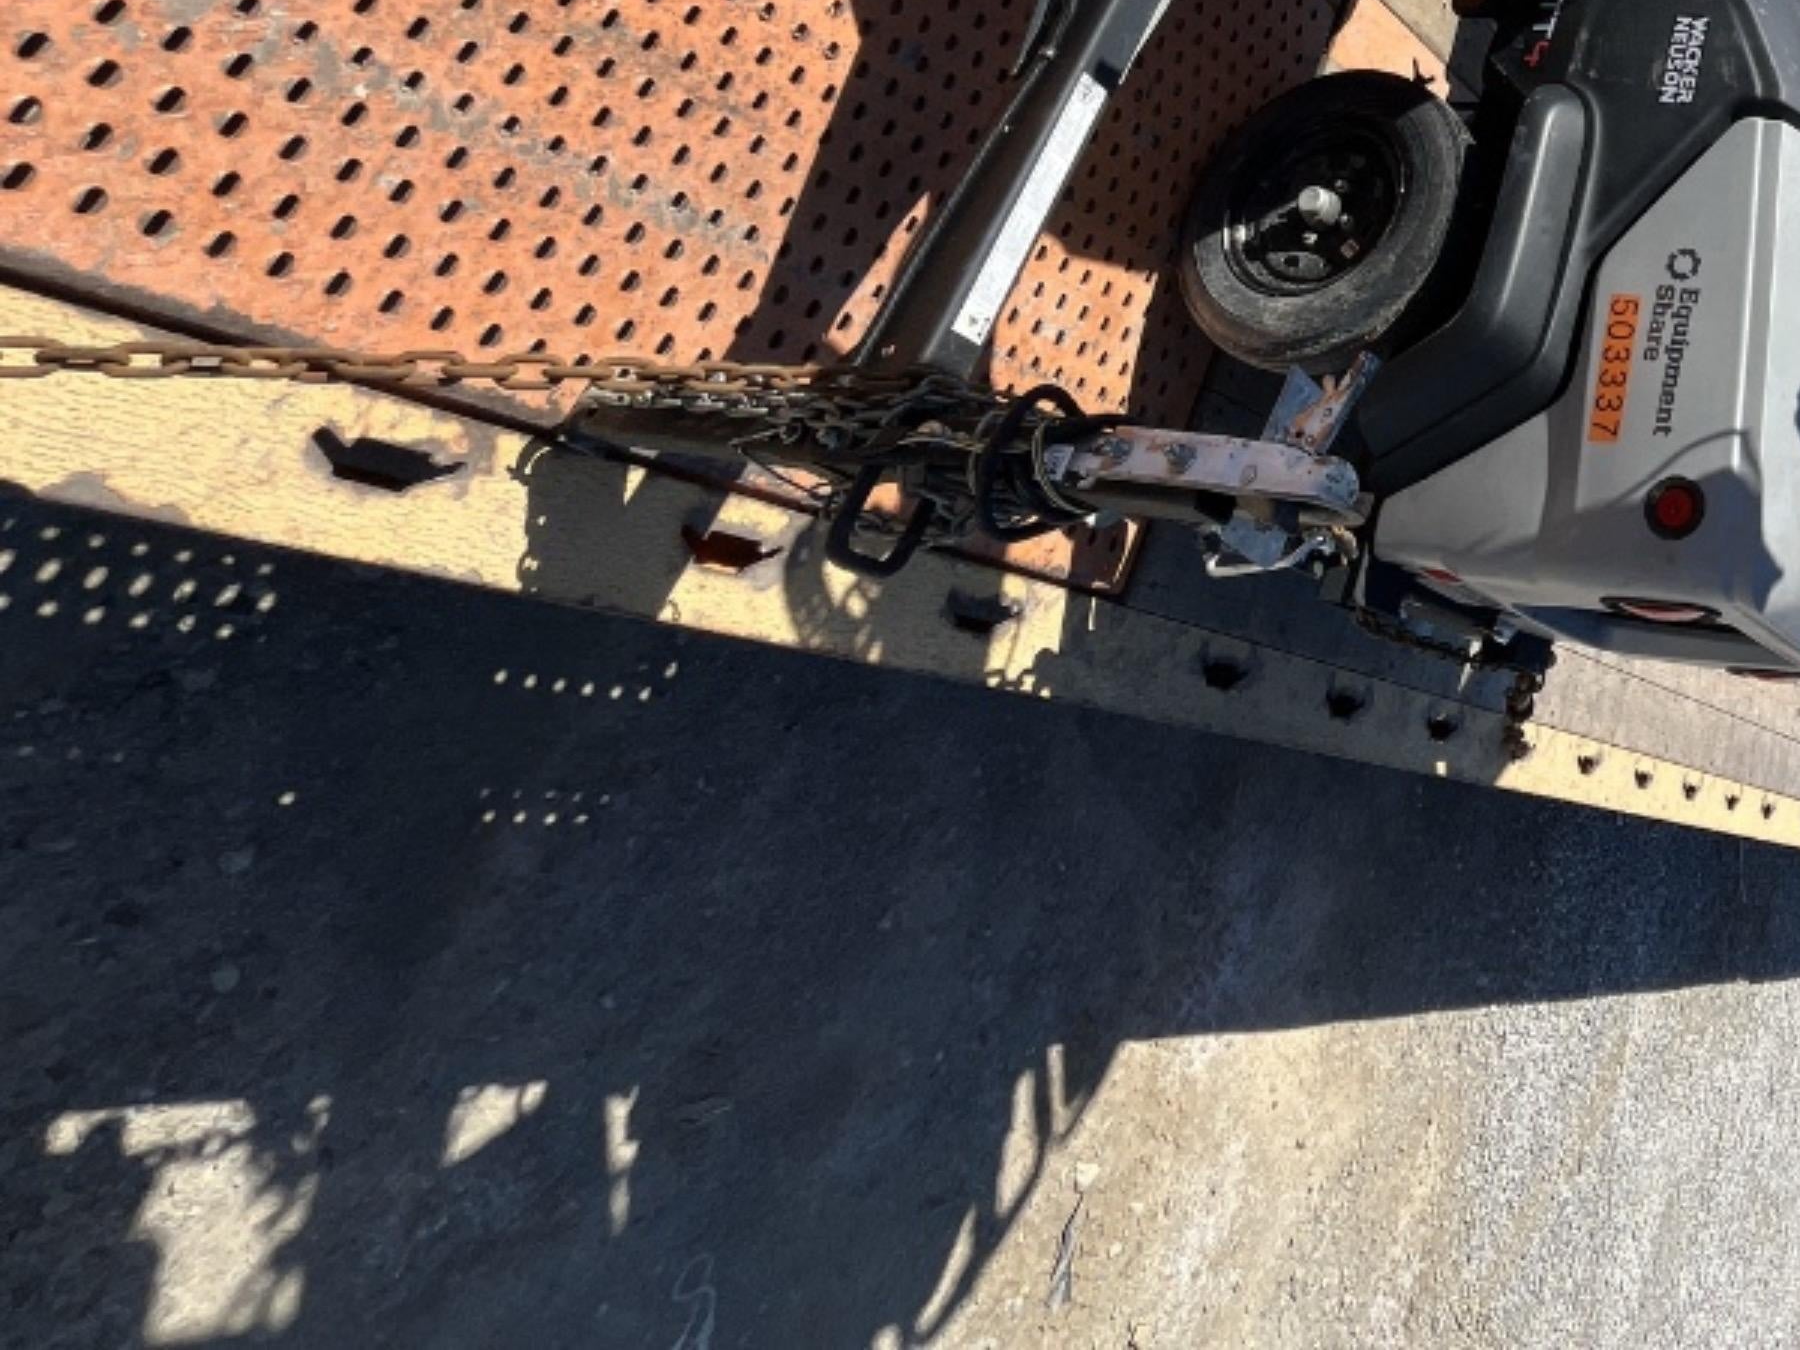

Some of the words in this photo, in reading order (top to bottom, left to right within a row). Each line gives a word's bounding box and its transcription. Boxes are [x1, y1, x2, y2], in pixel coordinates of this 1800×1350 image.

[1657, 16, 1691, 103] NEUSON
[1676, 17, 1709, 103] WACKER
[1642, 284, 1674, 362] Share
[1651, 286, 1699, 437] Equipment
[1590, 297, 1638, 438] 503337
